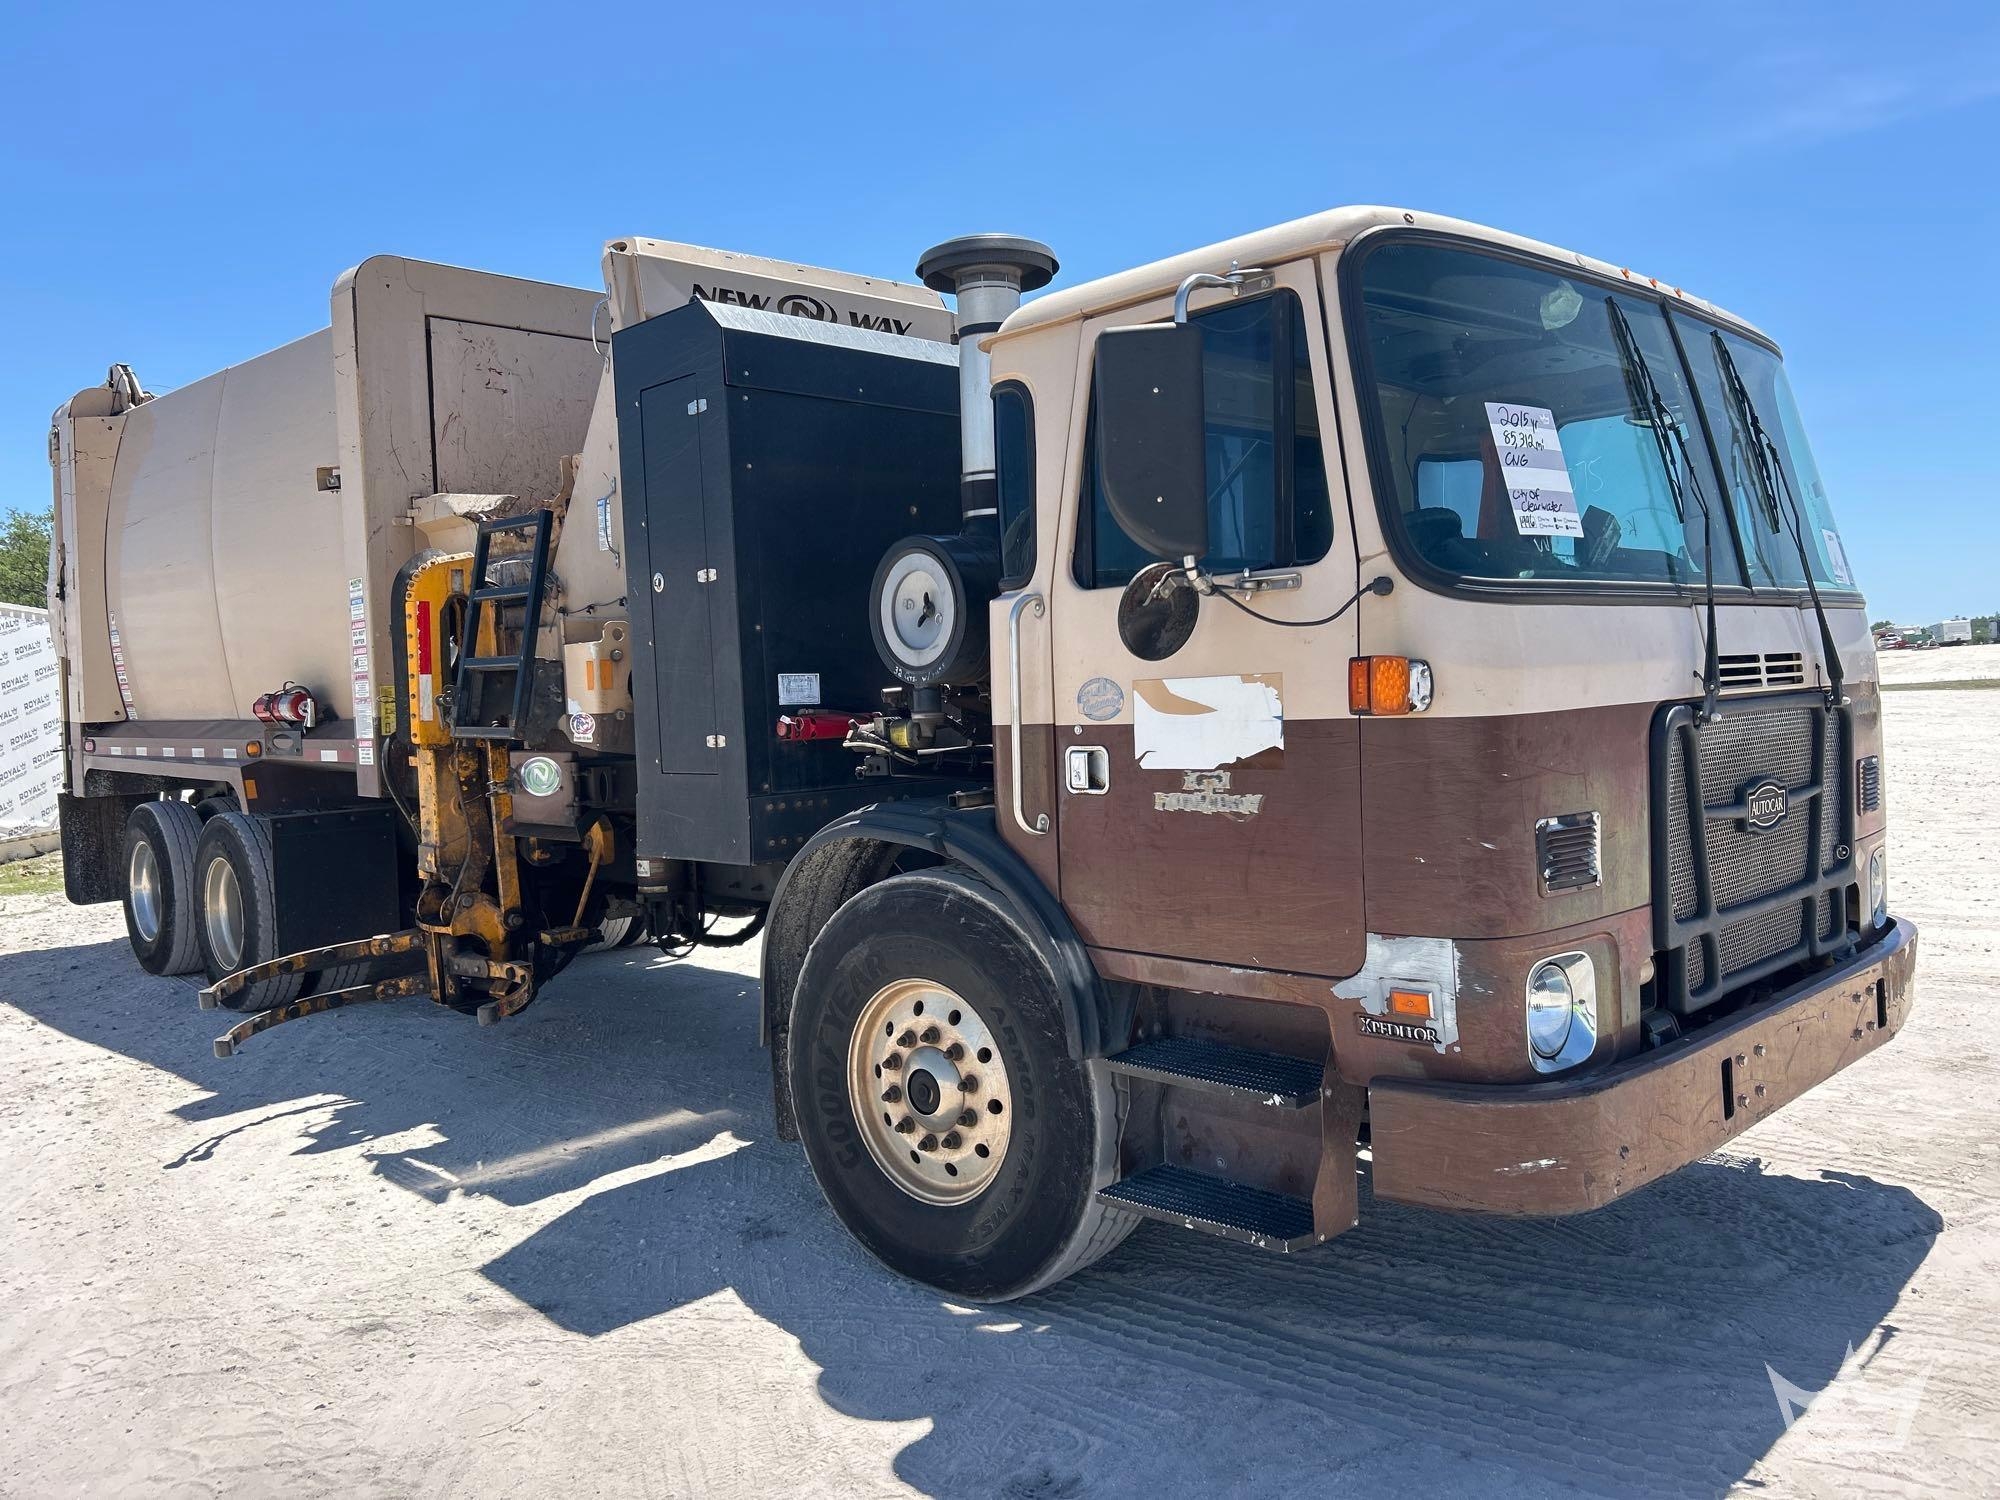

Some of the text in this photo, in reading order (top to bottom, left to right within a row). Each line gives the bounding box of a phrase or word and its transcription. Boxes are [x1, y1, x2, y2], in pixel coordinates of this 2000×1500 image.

[692, 284, 771, 310] NEW
[848, 311, 913, 336] WAY
[1498, 406, 1529, 427] 2015
[1503, 430, 1534, 449] 85,312
[1505, 452, 1528, 466] CNG
[1512, 489, 1527, 501] City
[1521, 501, 1562, 512] Clearwater
[15, 643, 36, 655] ROYAL
[34, 664, 54, 676] ROYAL
[1, 676, 23, 690] ROYAL
[24, 696, 44, 710] ROYAL
[10, 731, 32, 746] ROYAL
[32, 750, 53, 765] ROYAL
[19, 784, 41, 800] ROYAL
[1751, 797, 1784, 817] AUTOCAR
[1360, 1017, 1437, 1043] XPEDITOR
